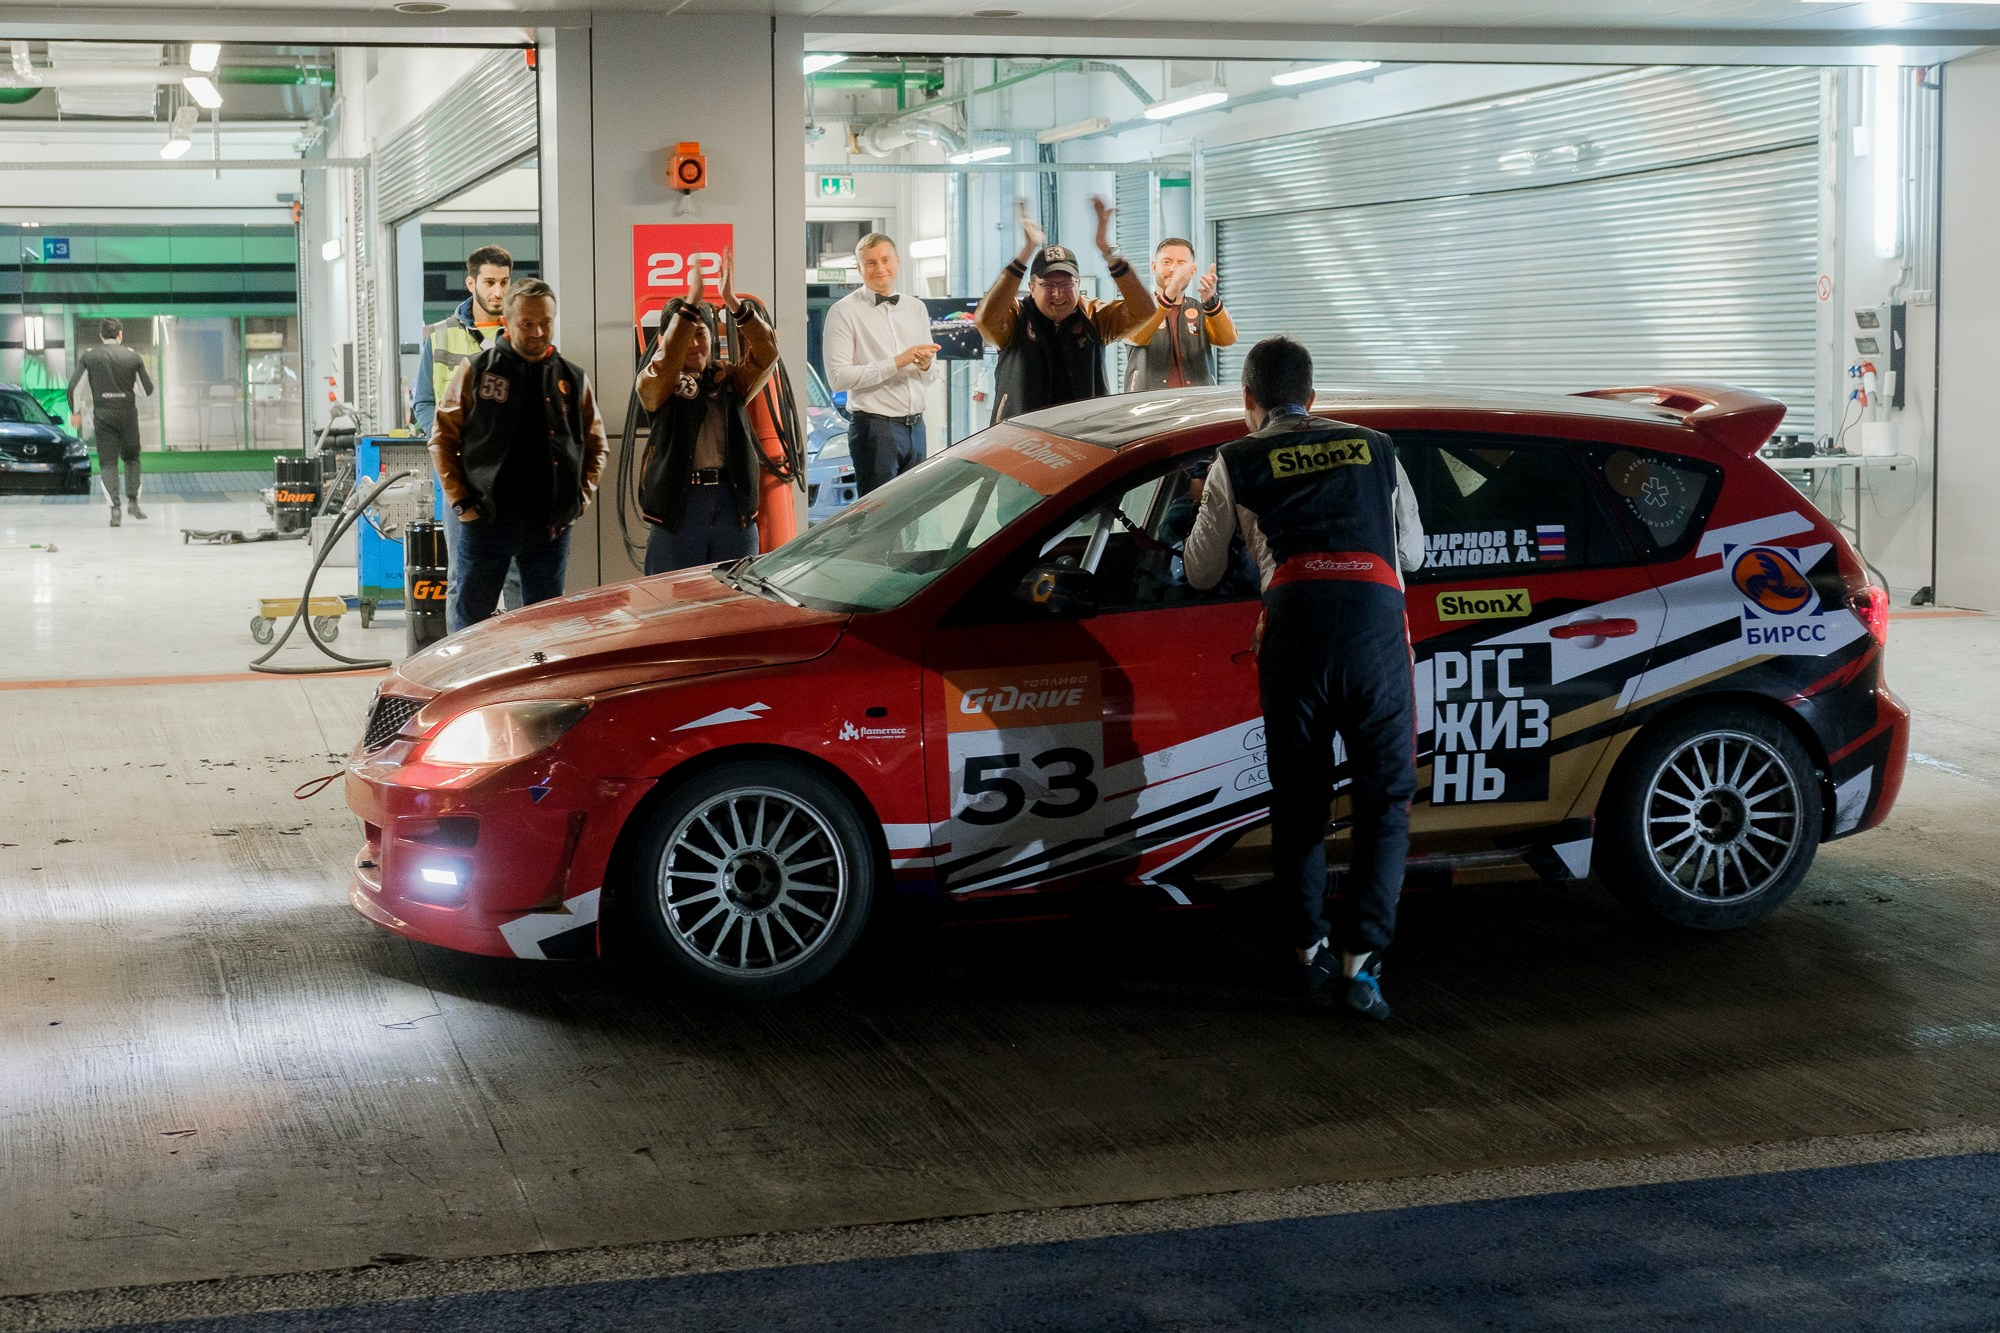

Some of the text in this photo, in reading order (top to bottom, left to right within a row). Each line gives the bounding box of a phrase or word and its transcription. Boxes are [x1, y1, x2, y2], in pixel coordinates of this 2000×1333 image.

[46, 243, 68, 255] 13
[1045, 246, 1065, 262] 53
[647, 252, 722, 287] 22
[819, 270, 845, 281] ВЫХОД
[481, 373, 508, 402] 53
[675, 373, 699, 399] 53
[1277, 443, 1365, 472] ShonX
[1513, 529, 1534, 547] В.
[1515, 546, 1537, 563] А.
[1442, 593, 1524, 616] ShonX
[1746, 624, 1826, 645] БИРСС
[1434, 648, 1525, 702] РГС
[860, 727, 907, 738] flamerace
[1434, 699, 1550, 752] ЖИЗ
[957, 747, 1099, 826] 53
[1432, 753, 1506, 803] НЬ
